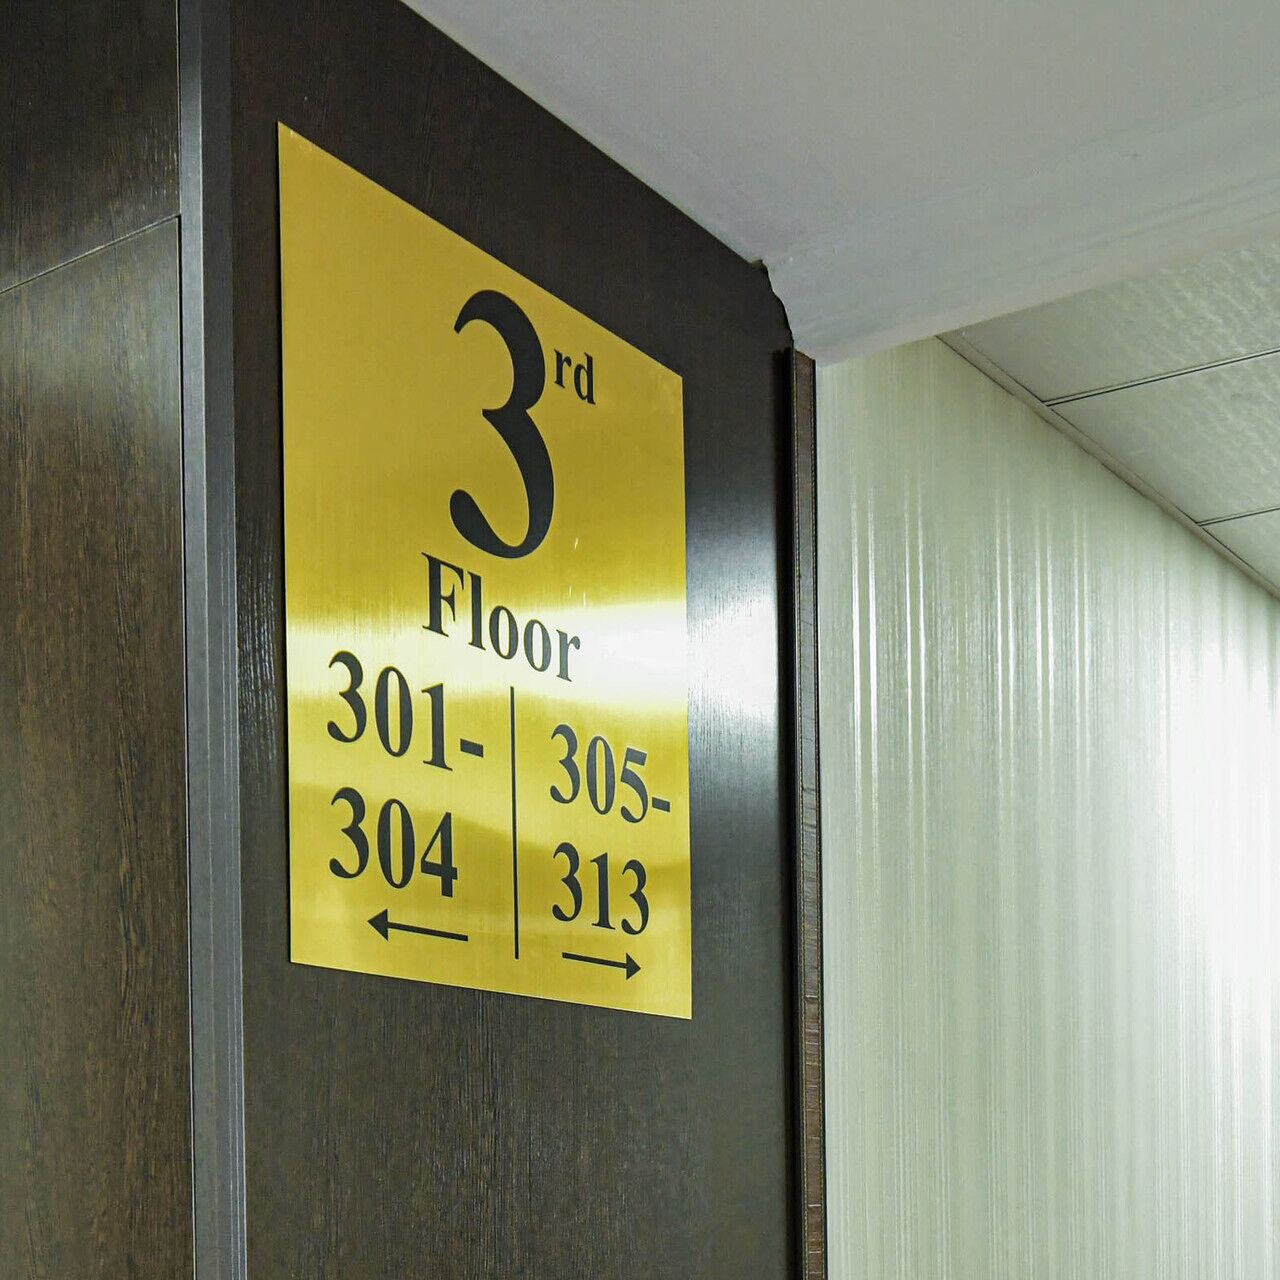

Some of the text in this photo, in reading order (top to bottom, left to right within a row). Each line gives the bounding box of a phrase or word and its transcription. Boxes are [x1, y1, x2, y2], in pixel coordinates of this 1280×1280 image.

[421, 551, 581, 683] Floor
[327, 650, 485, 772] 301-
[550, 724, 671, 824] 305-
[329, 786, 458, 899] 304
[551, 842, 650, 936] 313
